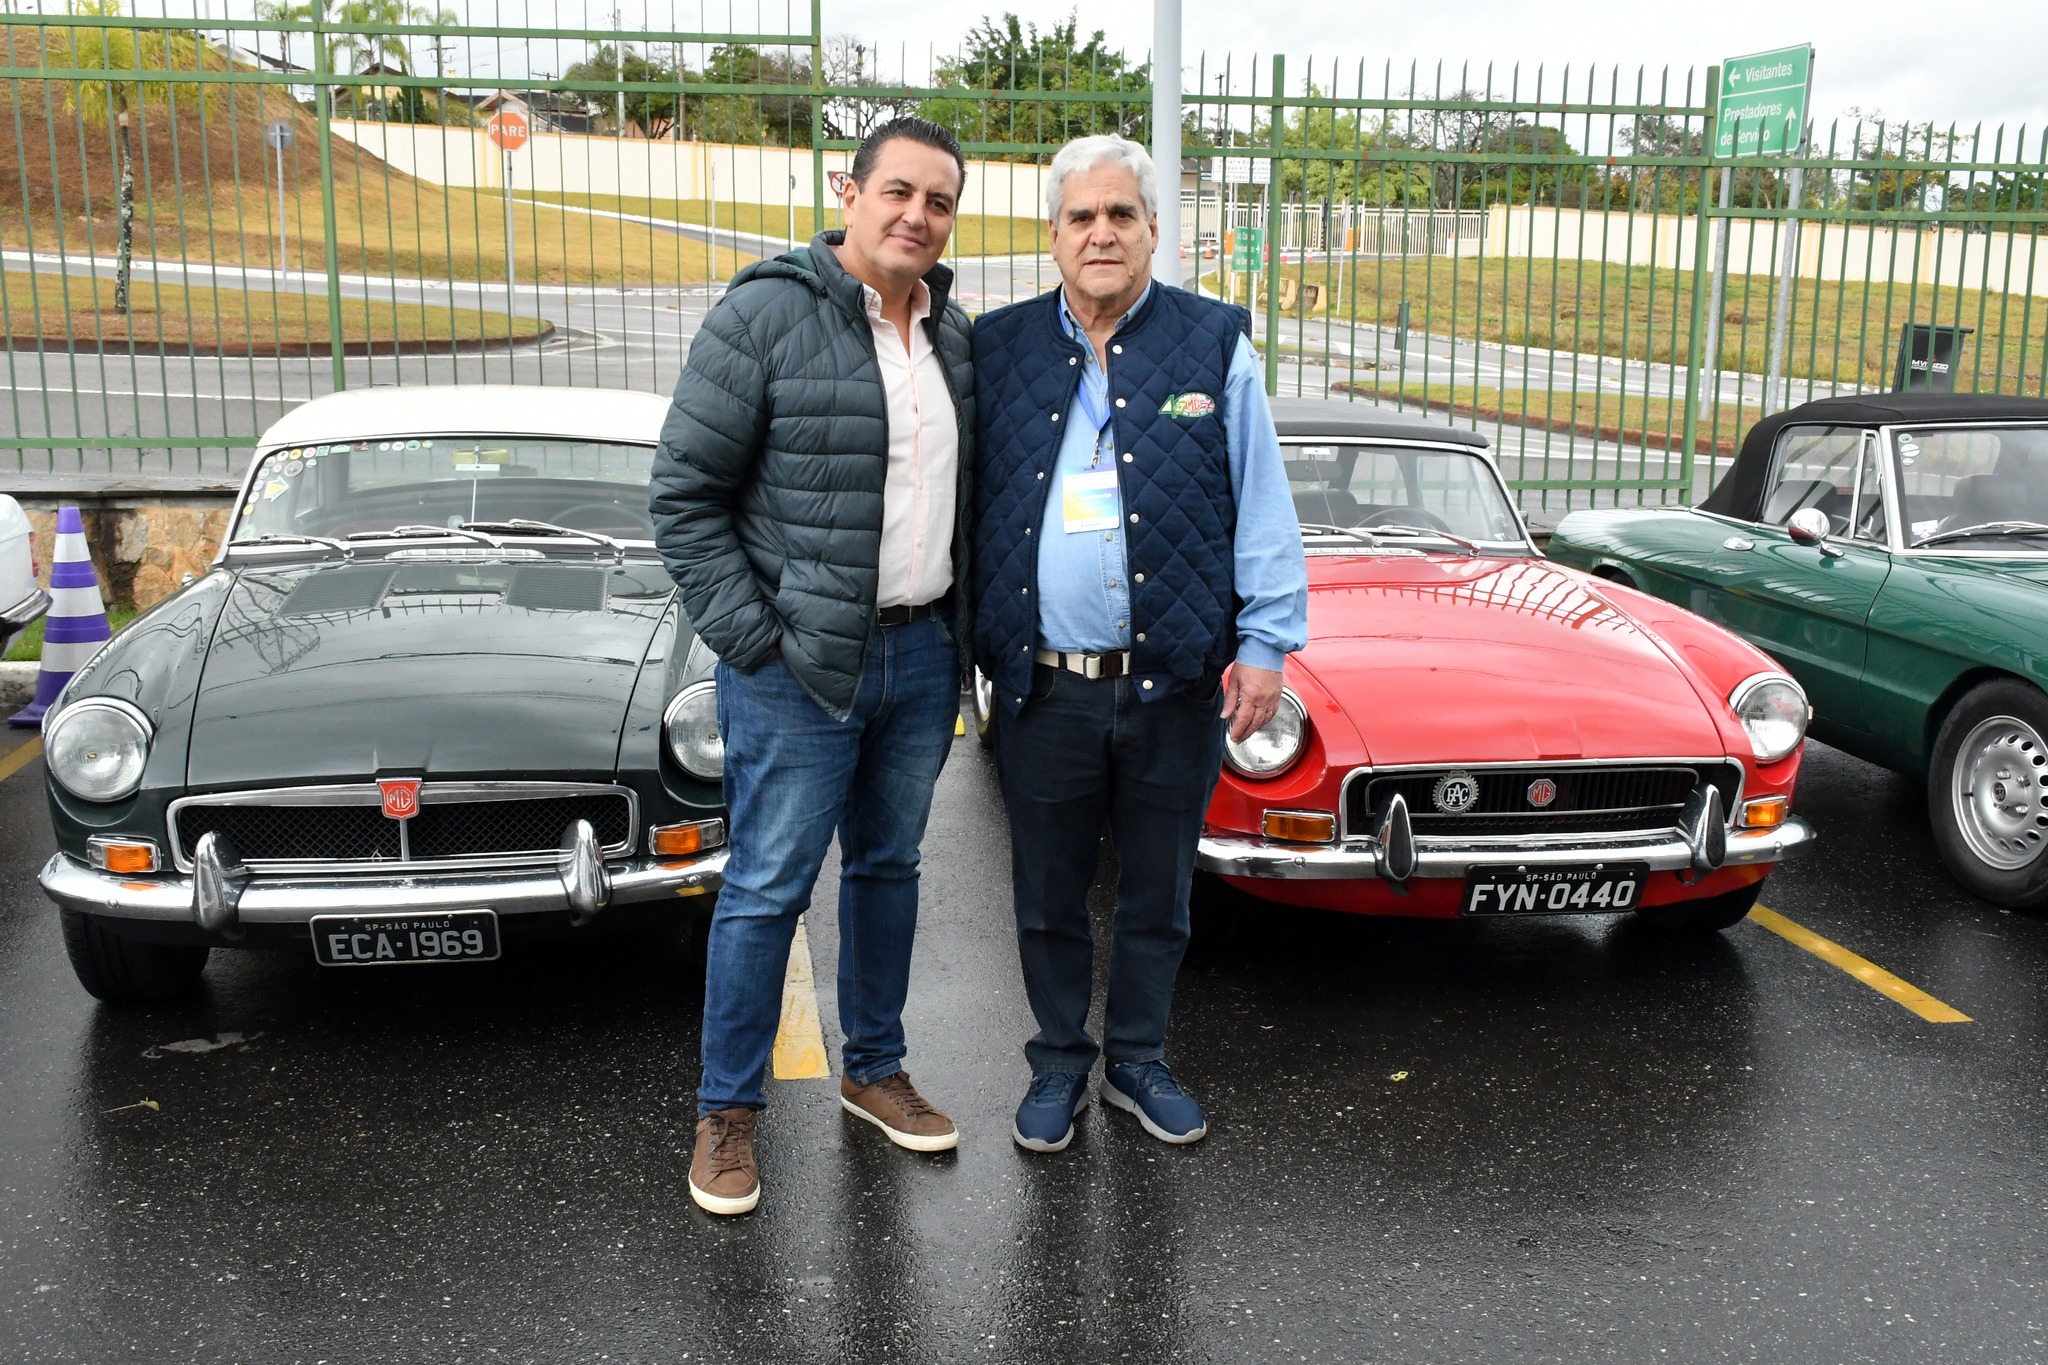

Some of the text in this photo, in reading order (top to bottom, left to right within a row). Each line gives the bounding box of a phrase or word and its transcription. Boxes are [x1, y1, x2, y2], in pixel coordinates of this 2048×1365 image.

[1746, 63, 1793, 83] Visitantes
[1724, 103, 1782, 122] Prestadores
[491, 124, 525, 138] PARE
[1721, 132, 1732, 146] de
[390, 789, 411, 808] MG
[1446, 784, 1469, 805] RAC
[1532, 783, 1551, 802] MG
[1526, 872, 1597, 882] SP-SÃO PAULO
[365, 920, 450, 931] SP-SÃO PAULO
[328, 929, 484, 960] ECA-1969
